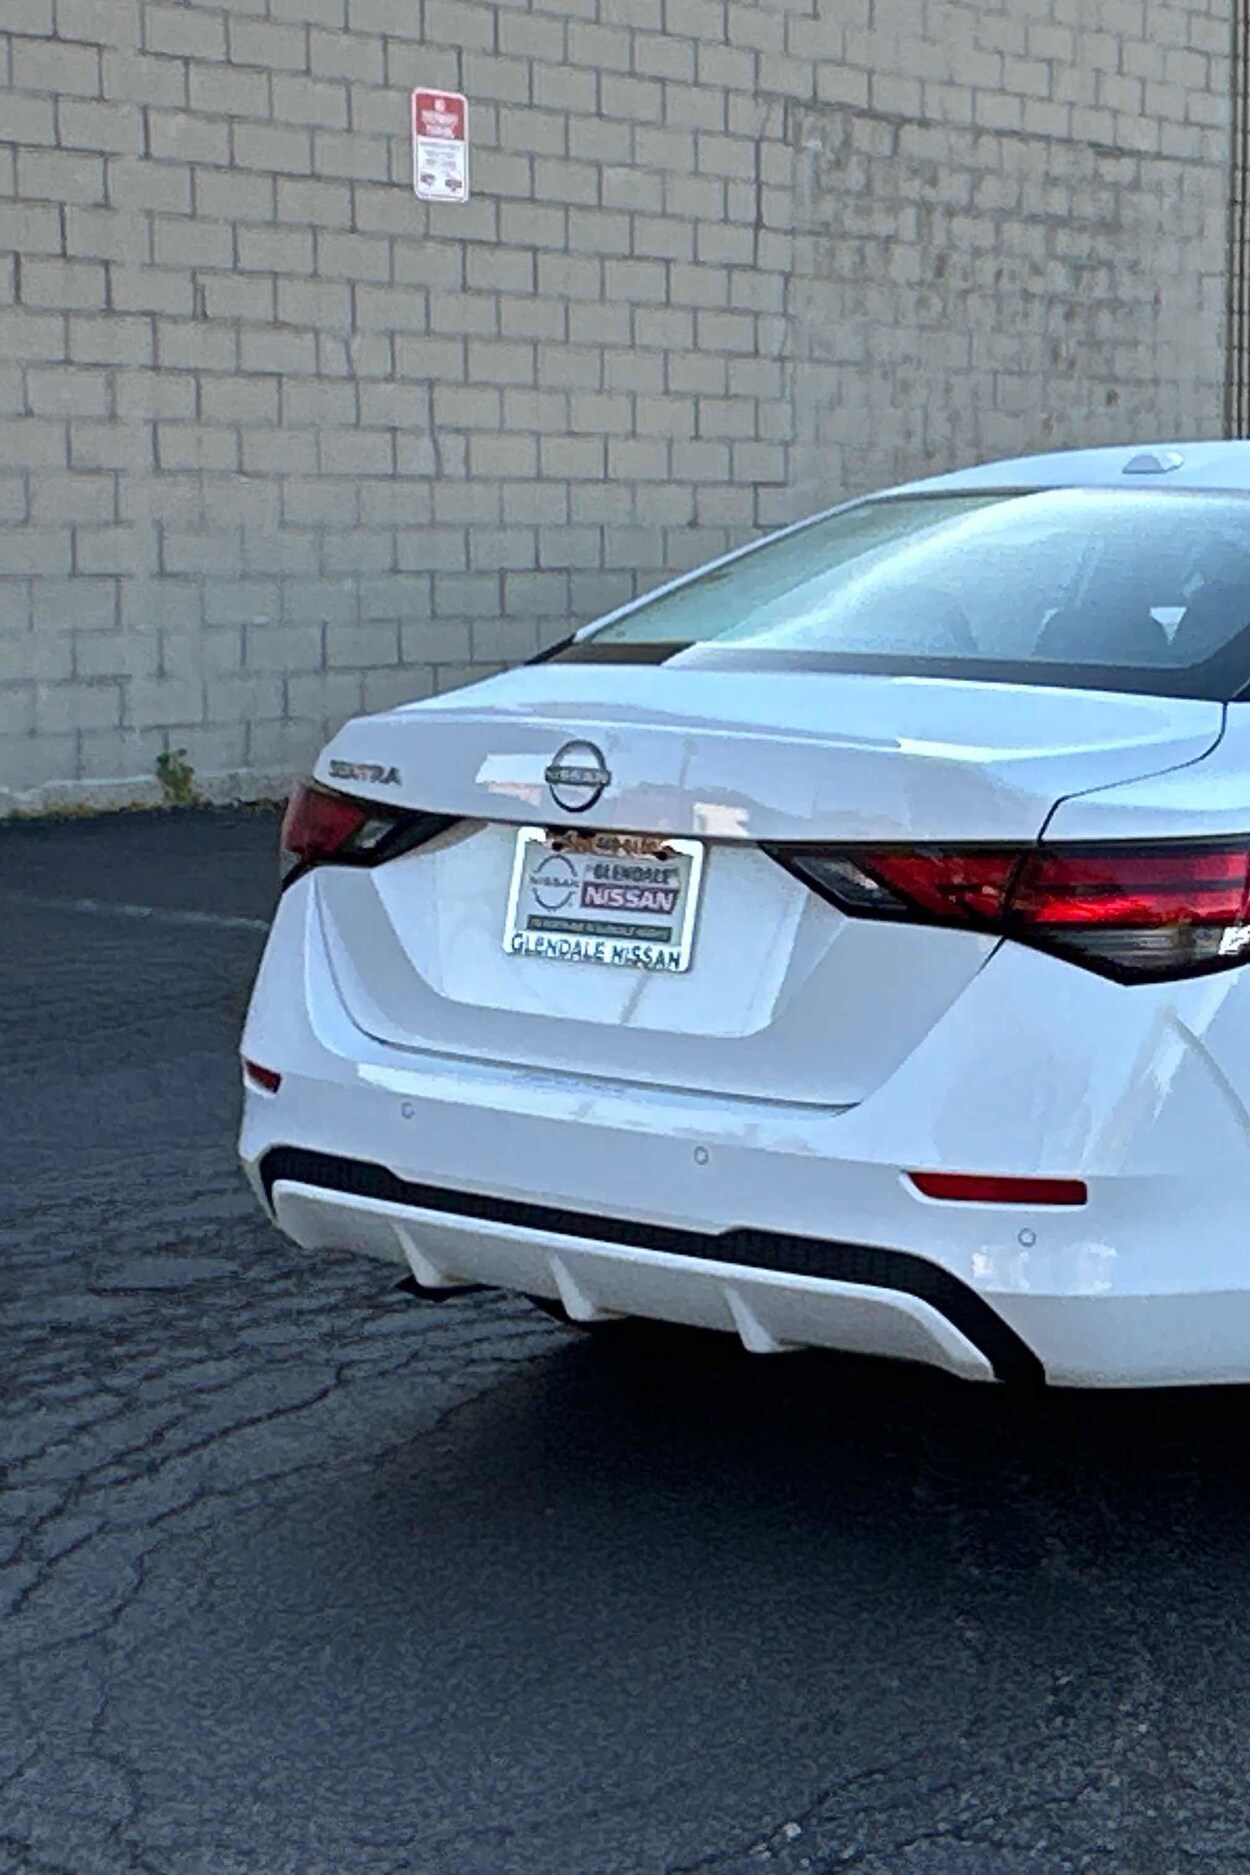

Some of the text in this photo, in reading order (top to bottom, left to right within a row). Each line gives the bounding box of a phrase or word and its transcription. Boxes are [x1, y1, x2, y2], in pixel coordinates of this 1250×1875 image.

[584, 886, 674, 911] NISSAN
[511, 932, 681, 968] GLENDALE NISSAN
